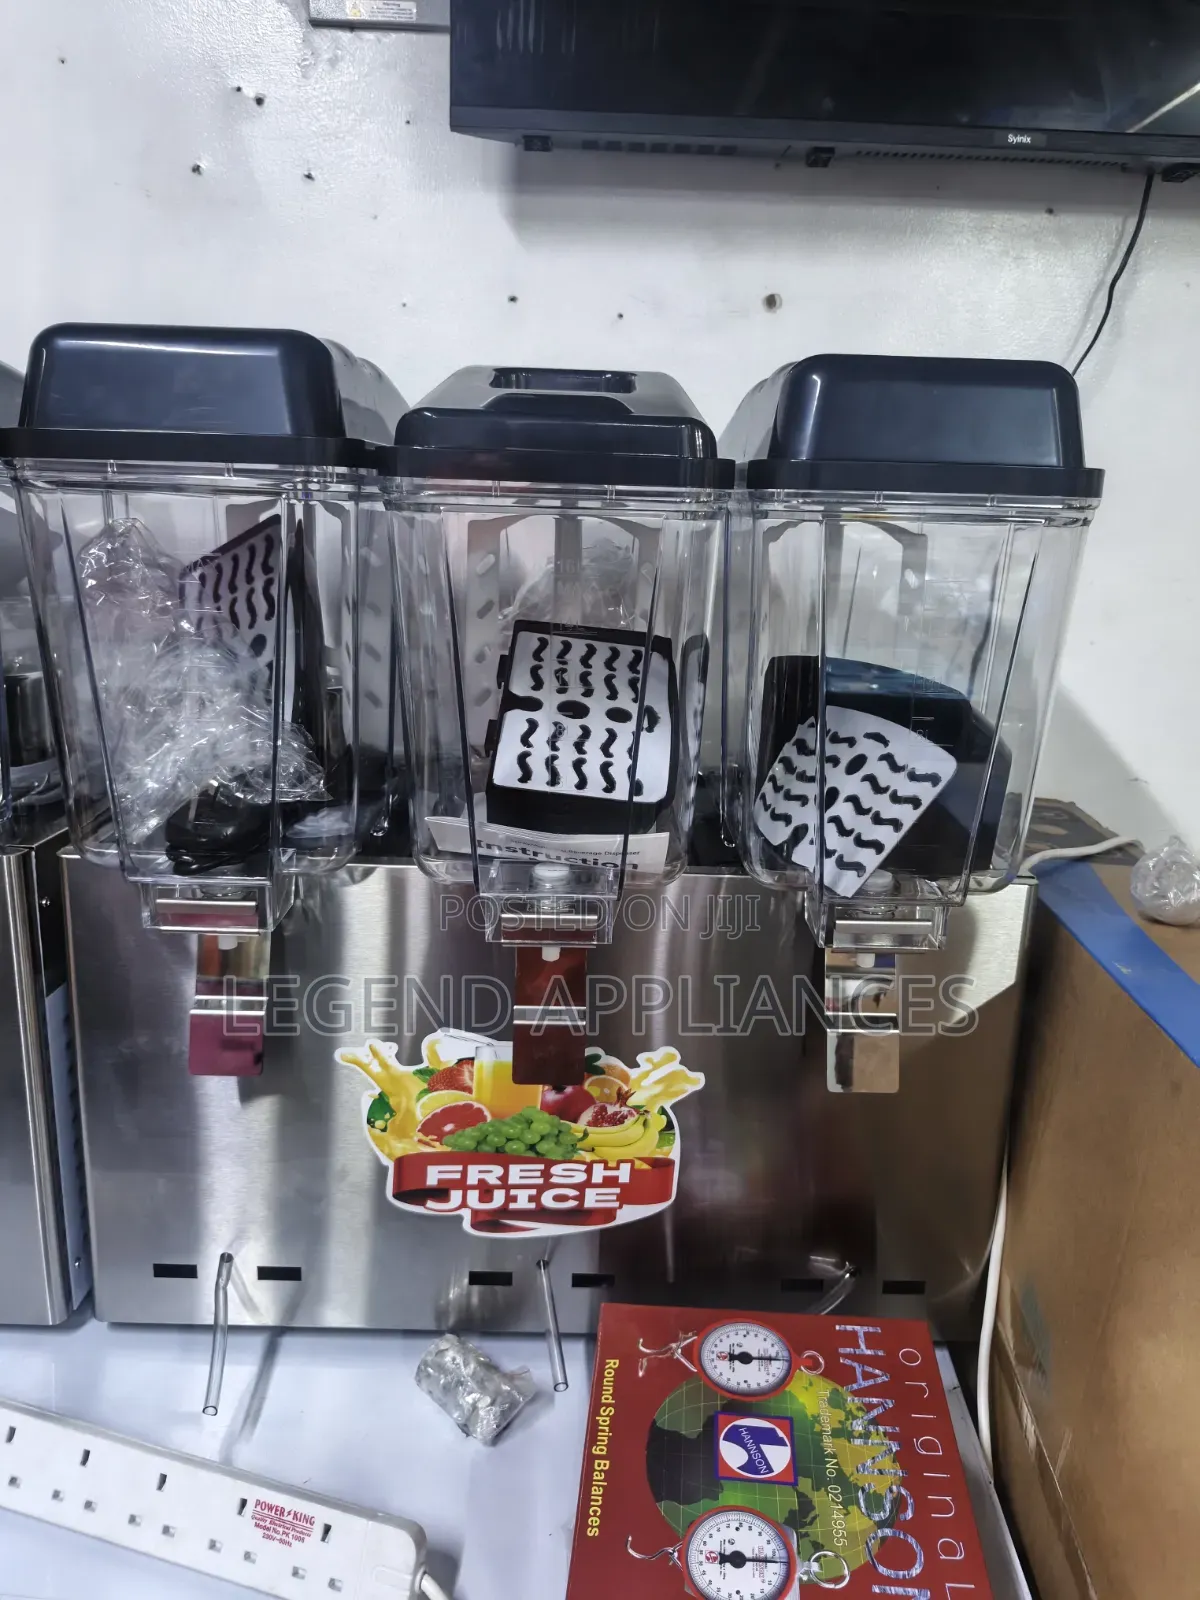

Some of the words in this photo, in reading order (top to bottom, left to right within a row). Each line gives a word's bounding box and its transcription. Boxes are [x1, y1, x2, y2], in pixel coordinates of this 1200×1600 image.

[426, 1162, 632, 1186] FRESH
[425, 1187, 621, 1211] JUICE
[601, 1359, 619, 1403] Round
[592, 1406, 615, 1455] Spring
[817, 1390, 837, 1455] Trademark
[738, 1427, 770, 1474] HANNSON
[824, 1458, 839, 1480] No.
[254, 1499, 285, 1517] POWER
[292, 1510, 315, 1526] KING
[586, 1460, 610, 1537] Balances
[827, 1484, 848, 1547] 0214955
[254, 1521, 272, 1532] Model
